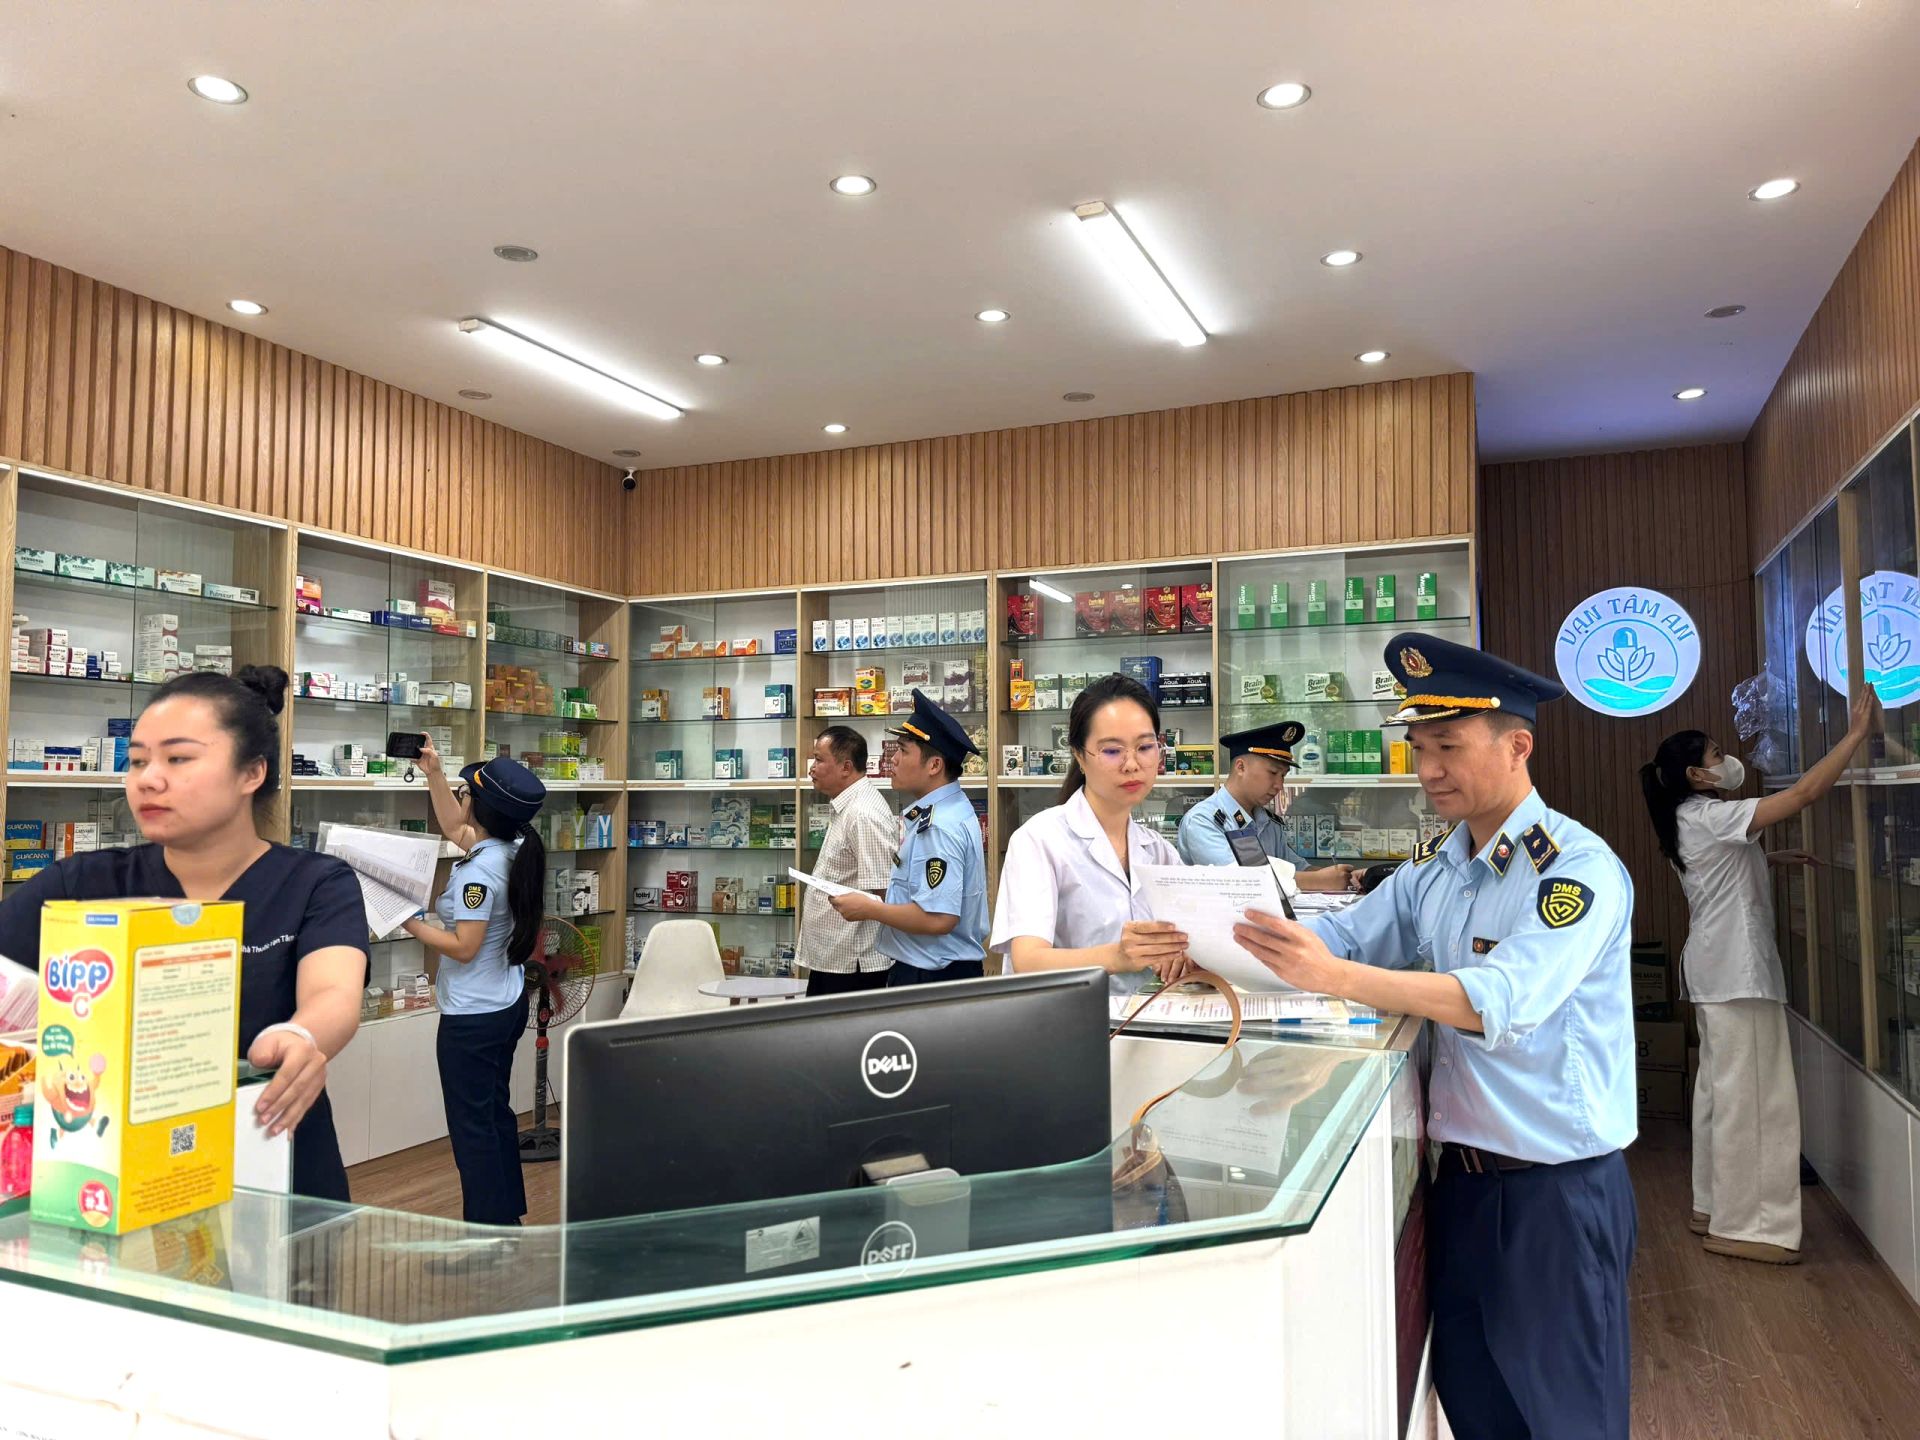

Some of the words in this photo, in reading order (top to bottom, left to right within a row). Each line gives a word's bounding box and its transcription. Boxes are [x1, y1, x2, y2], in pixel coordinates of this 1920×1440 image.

[1559, 604, 1602, 645] VẠN
[1608, 594, 1661, 618] TÂM
[1661, 613, 1696, 642] AN
[1552, 882, 1581, 897] DMS
[73, 996, 89, 1018] C
[867, 1054, 912, 1076] DELL
